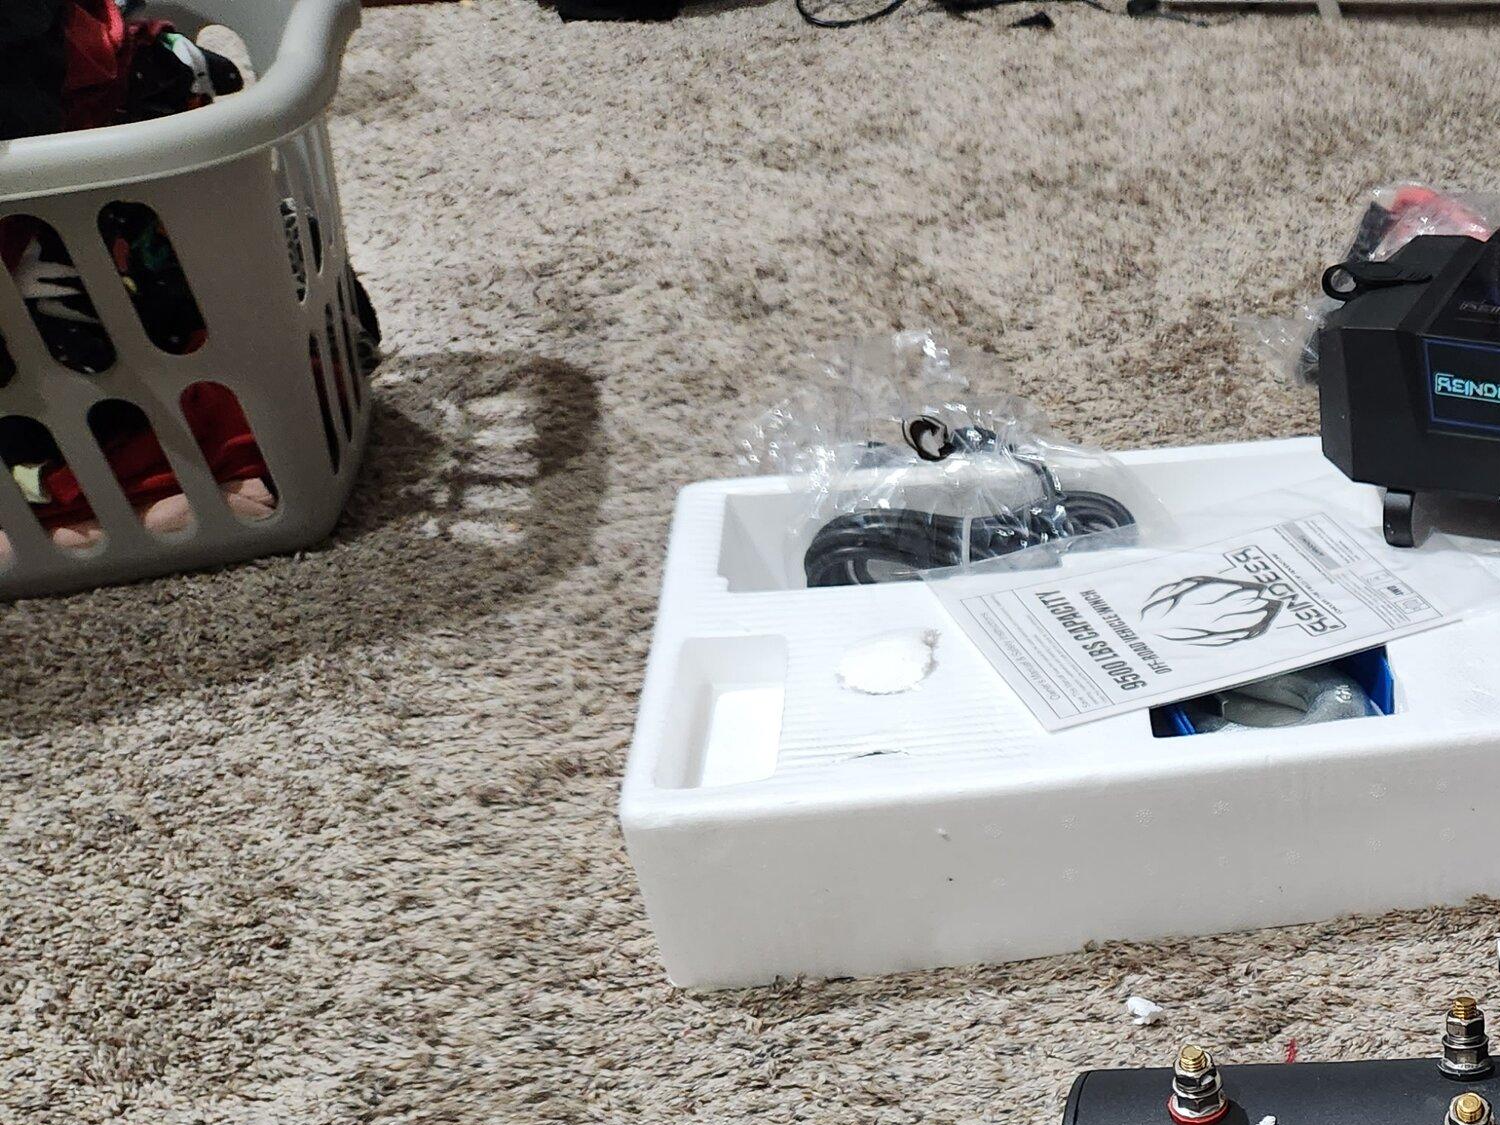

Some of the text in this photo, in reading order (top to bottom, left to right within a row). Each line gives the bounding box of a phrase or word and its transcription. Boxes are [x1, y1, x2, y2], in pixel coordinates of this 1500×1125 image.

[1033, 588, 1101, 641] CAPACITY
[1232, 548, 1340, 632] REINDEER
[1078, 589, 1172, 674] OFF-ROAD VEHICLE WINCH
[1081, 639, 1120, 662] LBS
[1099, 659, 1148, 691] 9500
